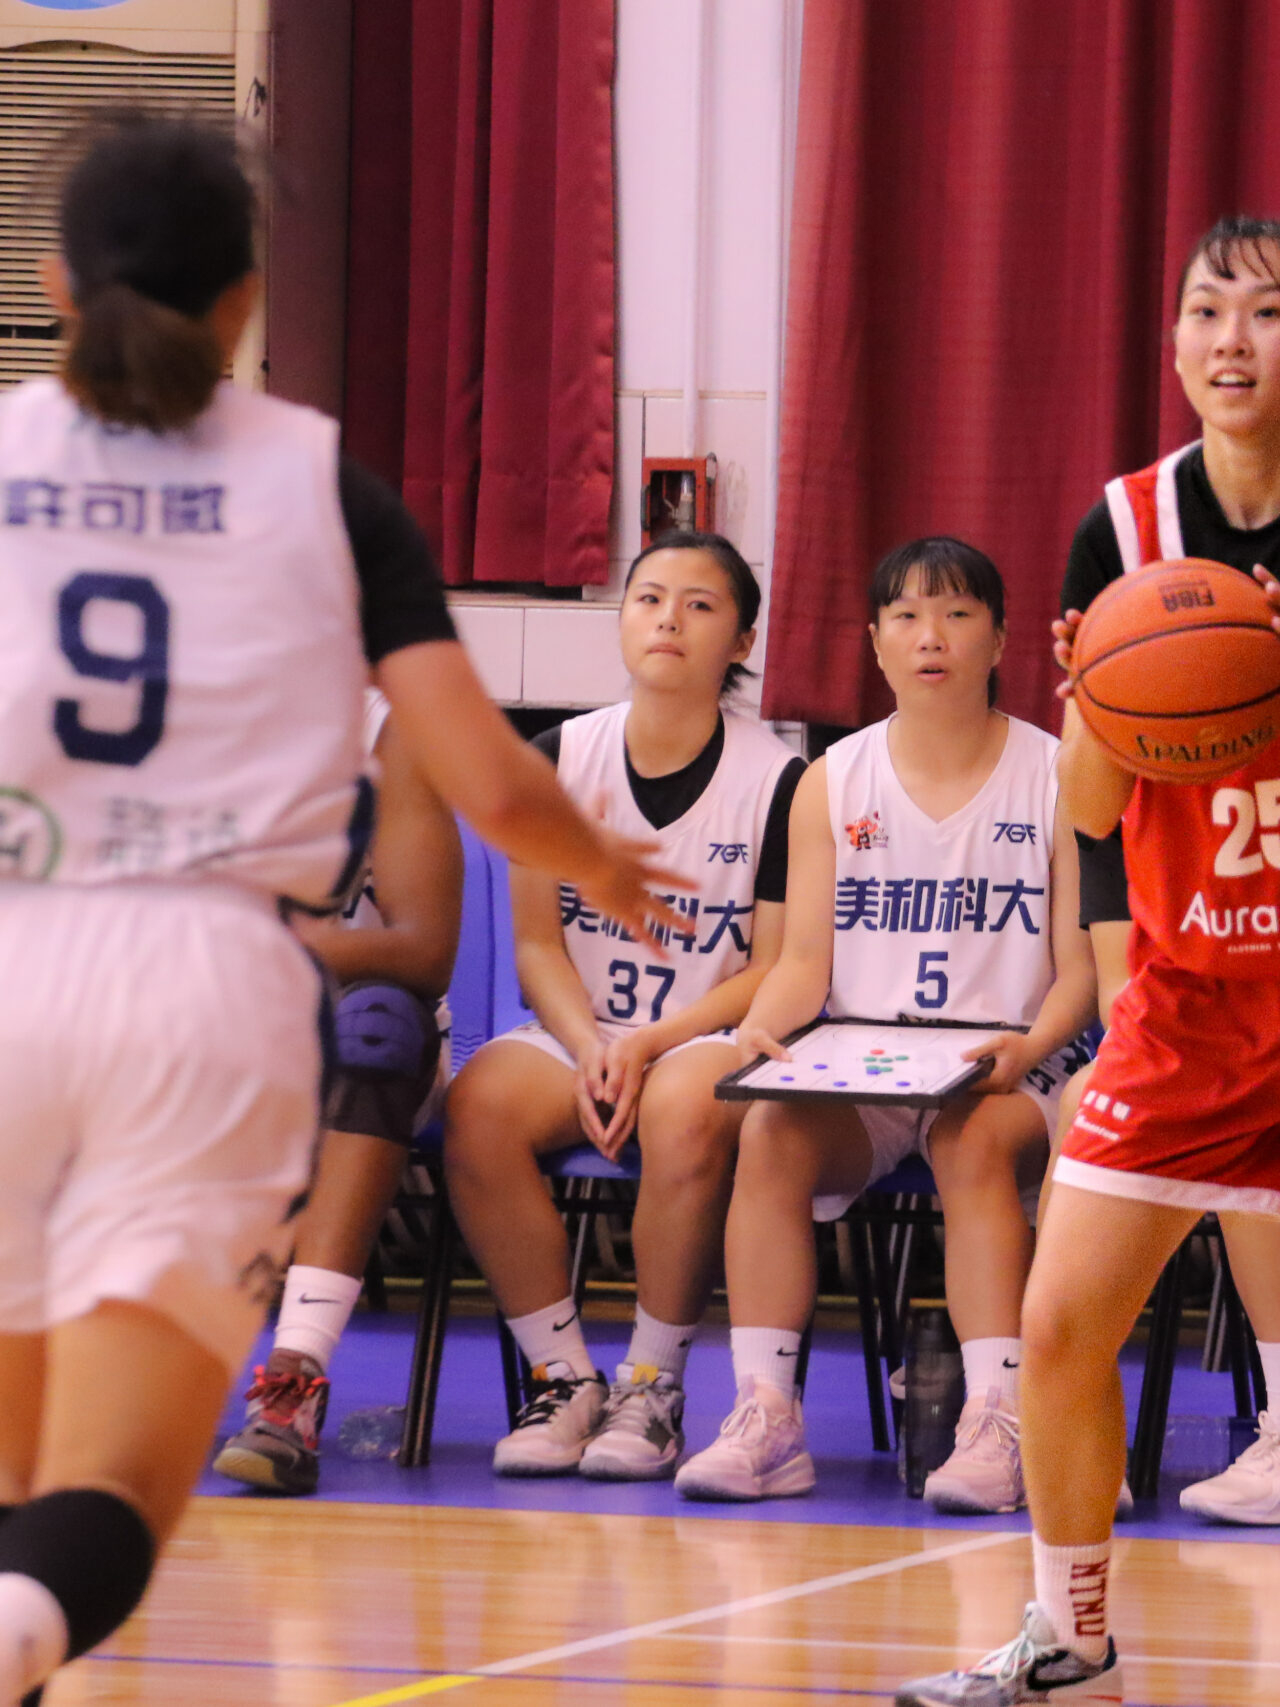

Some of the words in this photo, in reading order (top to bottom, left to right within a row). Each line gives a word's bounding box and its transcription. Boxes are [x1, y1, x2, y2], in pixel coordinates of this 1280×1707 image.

[54, 570, 169, 768] 9
[835, 877, 1044, 934] 美和科大
[607, 959, 676, 1022] 37
[915, 952, 949, 1008] 5
[1068, 1557, 1109, 1636] NTNU
